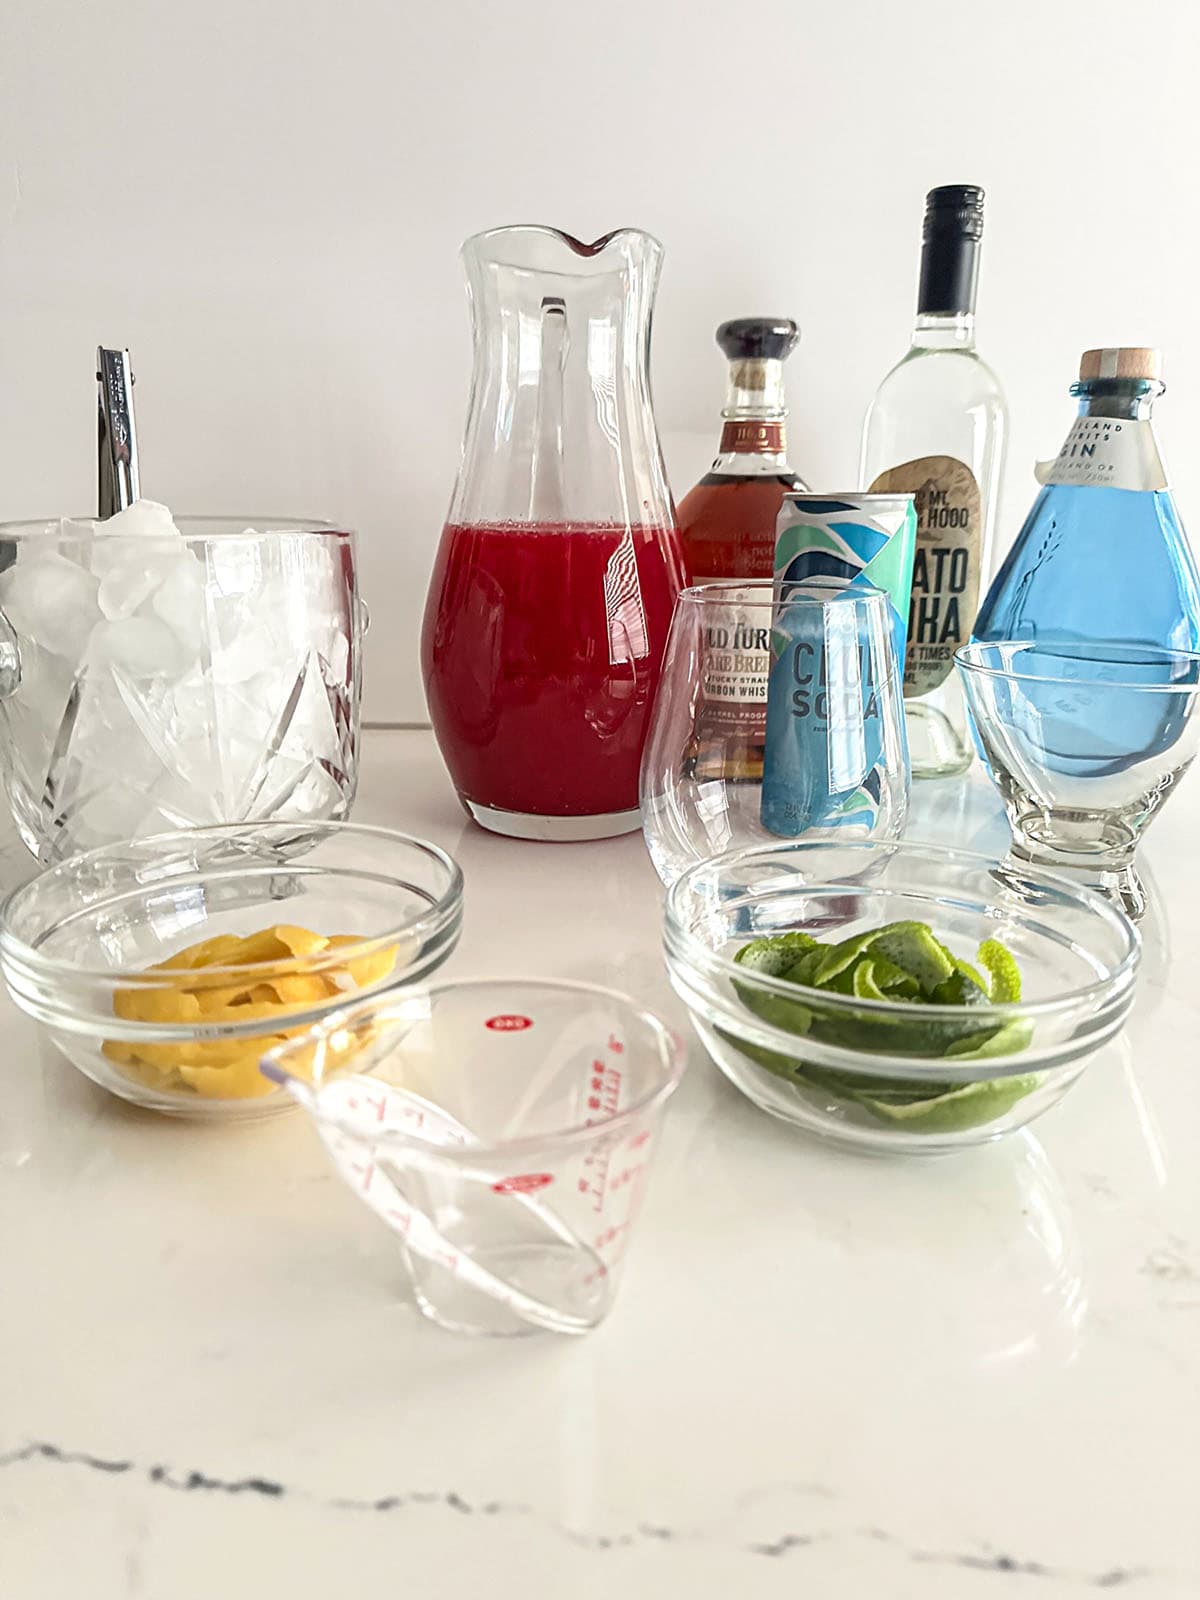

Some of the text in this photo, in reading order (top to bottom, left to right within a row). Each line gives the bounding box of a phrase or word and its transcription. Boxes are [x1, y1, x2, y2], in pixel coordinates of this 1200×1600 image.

[1060, 443, 1096, 457] GIN
[928, 507, 969, 528] HOOD
[911, 548, 969, 594] ATO
[732, 622, 772, 651] TUR
[919, 646, 950, 661] TIMES
[739, 686, 766, 697] WHIS
